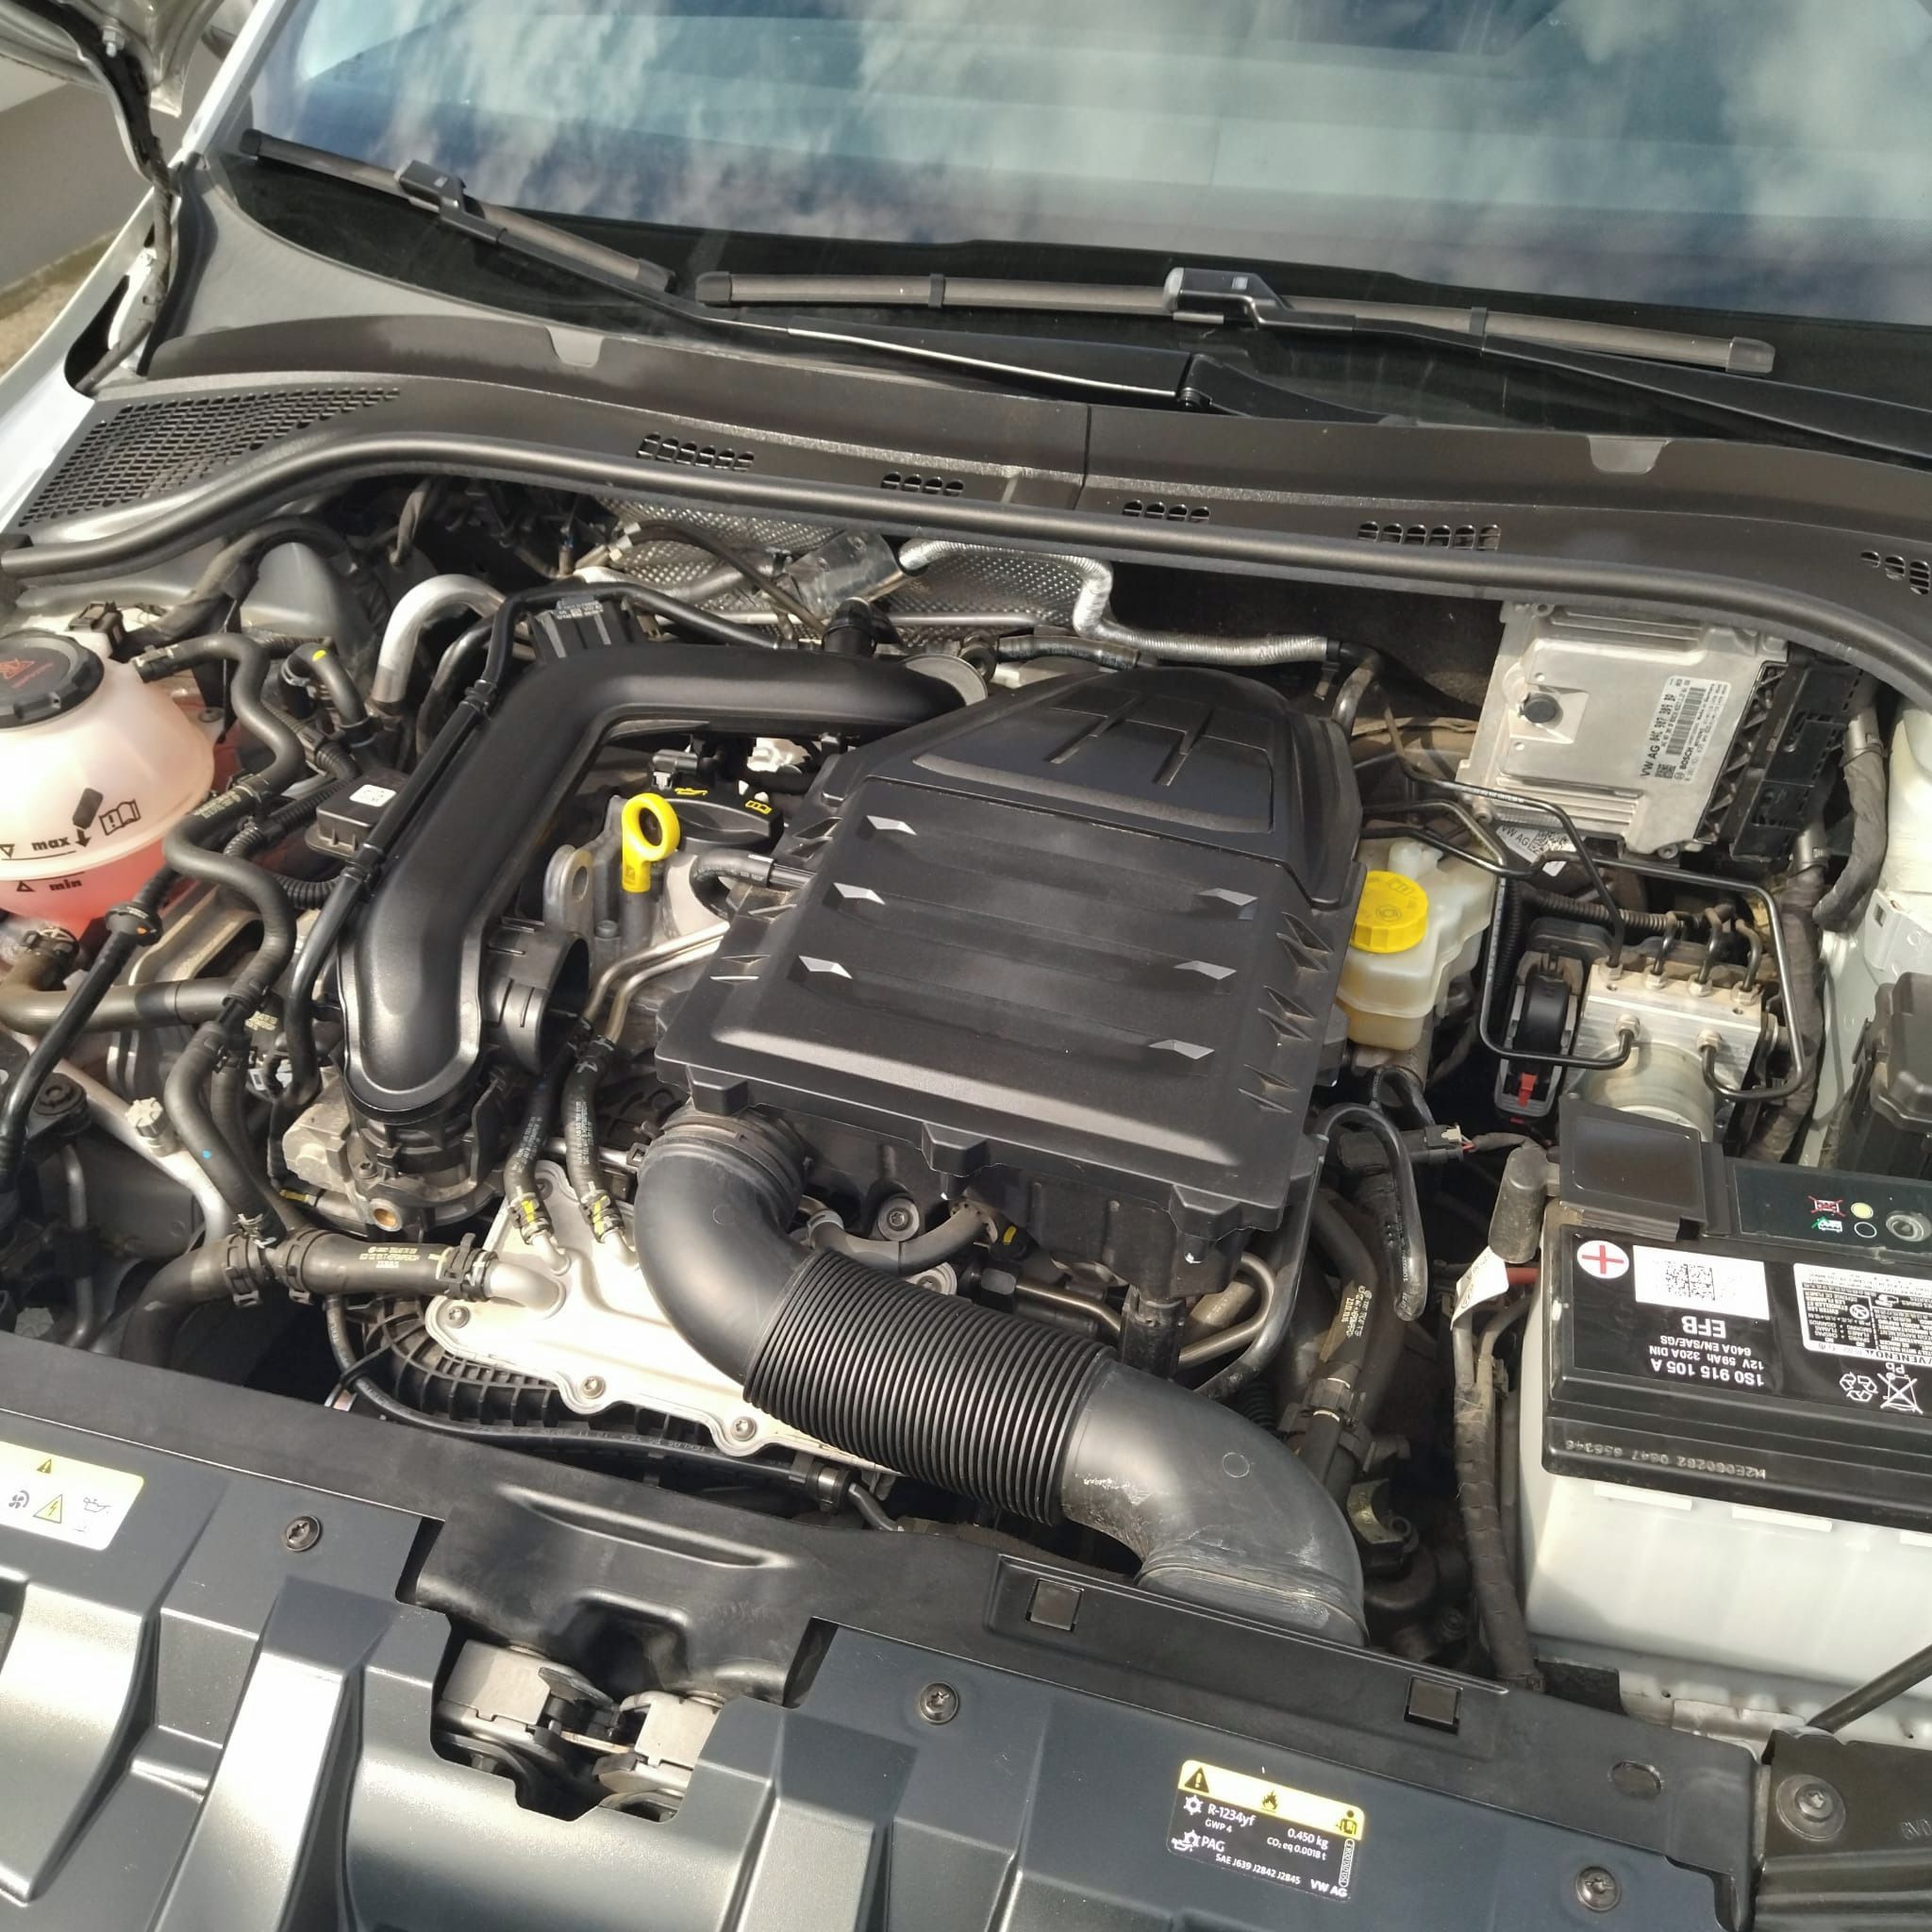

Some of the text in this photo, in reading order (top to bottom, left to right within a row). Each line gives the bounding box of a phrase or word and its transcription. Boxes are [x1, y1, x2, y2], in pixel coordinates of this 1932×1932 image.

[1640, 760, 1654, 777] VW
[1647, 745, 1660, 759] AG
[1679, 747, 1694, 770] BOSCH
[32, 836, 72, 851] max
[1500, 824, 1530, 847] VW AG
[49, 879, 83, 892] min
[1681, 1315, 1726, 1339] EFB
[1660, 1336, 1752, 1357] 640A EN/SAE/GS
[1649, 1345, 1764, 1371] 12V 59Ah 320A DIN
[1885, 1362, 1906, 1374] Pb
[1650, 1358, 1764, 1387] 1S0 915 105 A
[1208, 1804, 1257, 1826] R-1234yf
[1205, 1819, 1233, 1834] GWP 4
[1201, 1836, 1225, 1853] PAG
[1282, 1843, 1293, 1853] eq
[1294, 1844, 1321, 1858] 0.0018
[1321, 1851, 1326, 1860] t
[1316, 1834, 1329, 1851] kg
[1215, 1853, 1302, 1885] SAE J639 J2842 J2845
[1309, 1879, 1348, 1898] VW AG
